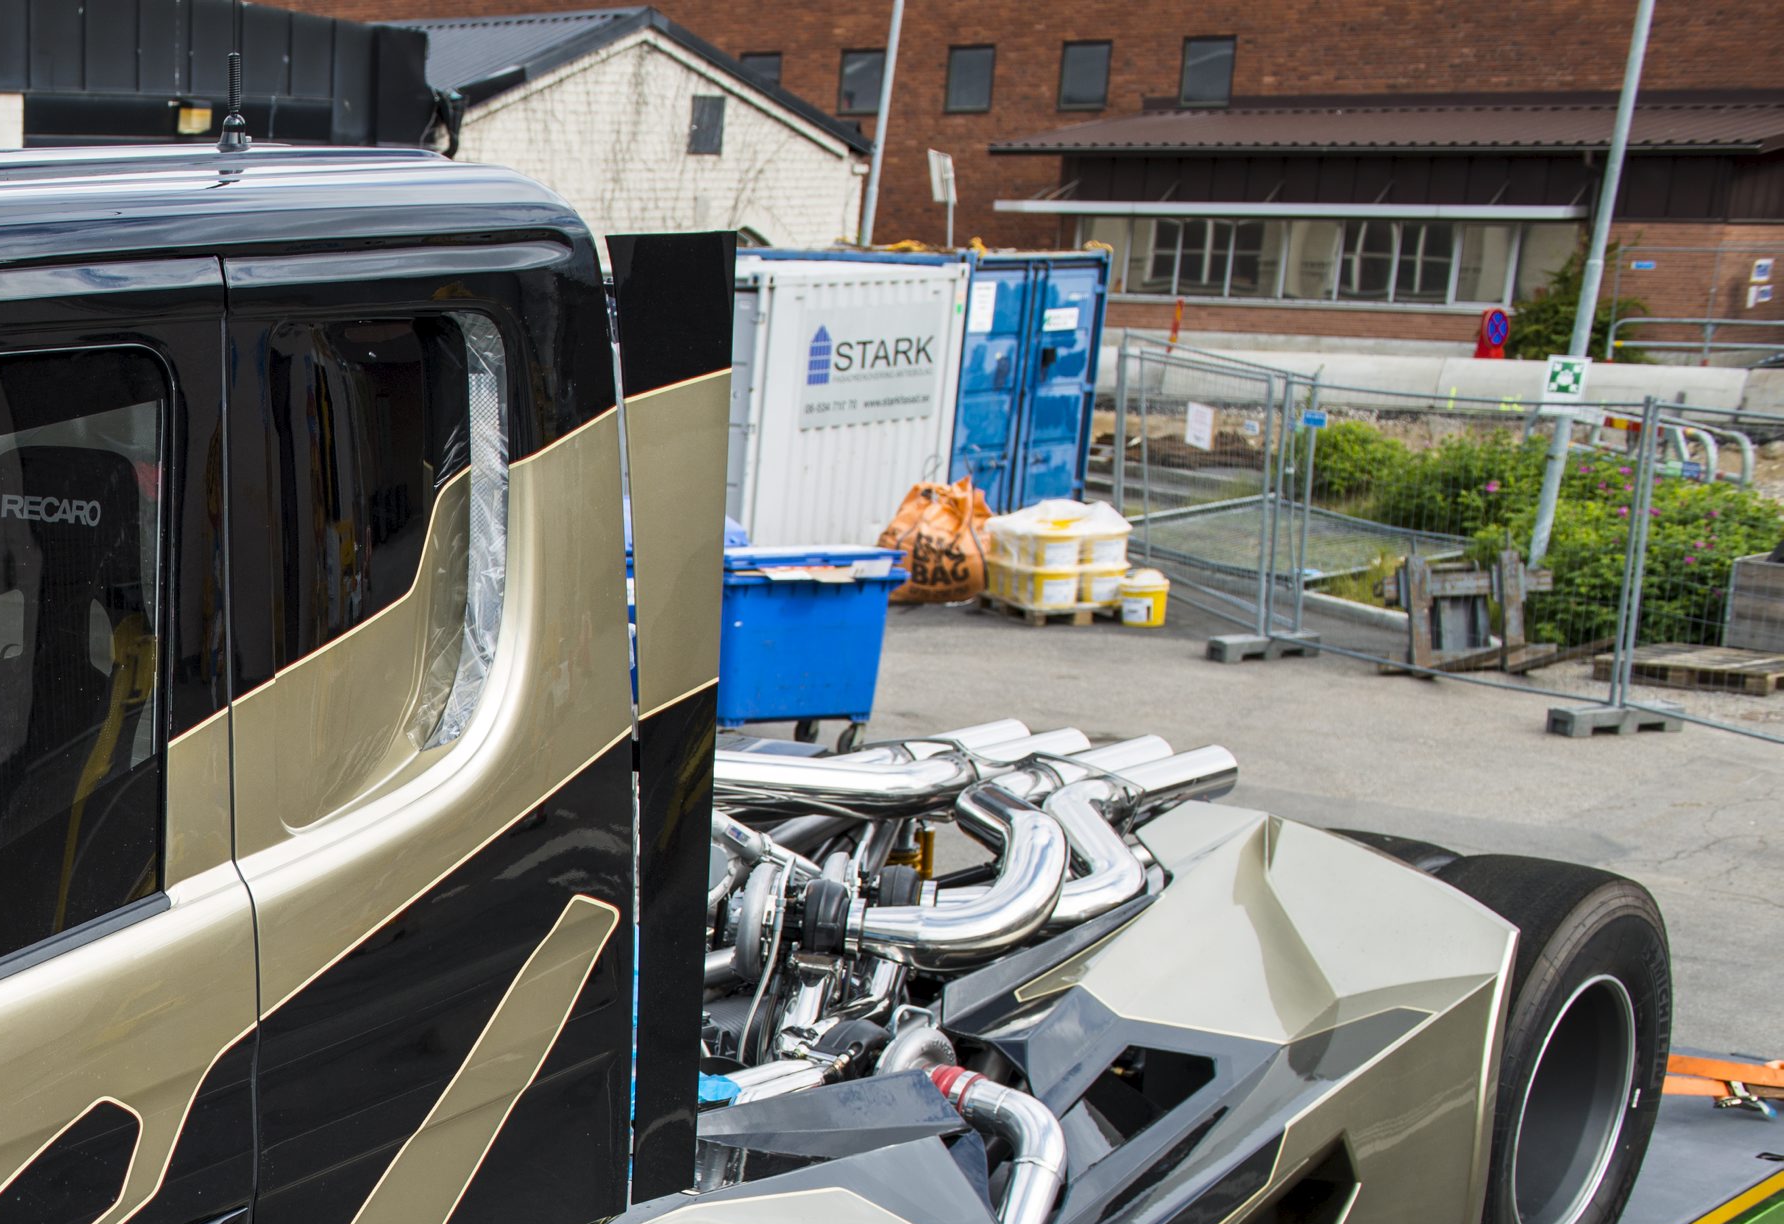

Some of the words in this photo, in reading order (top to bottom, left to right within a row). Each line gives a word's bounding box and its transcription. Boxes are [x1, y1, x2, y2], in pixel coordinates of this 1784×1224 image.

[834, 334, 934, 372] STARK
[0, 494, 102, 527] RECARO
[912, 560, 971, 585] BAG
[1653, 957, 1670, 1079] MICHELIN
